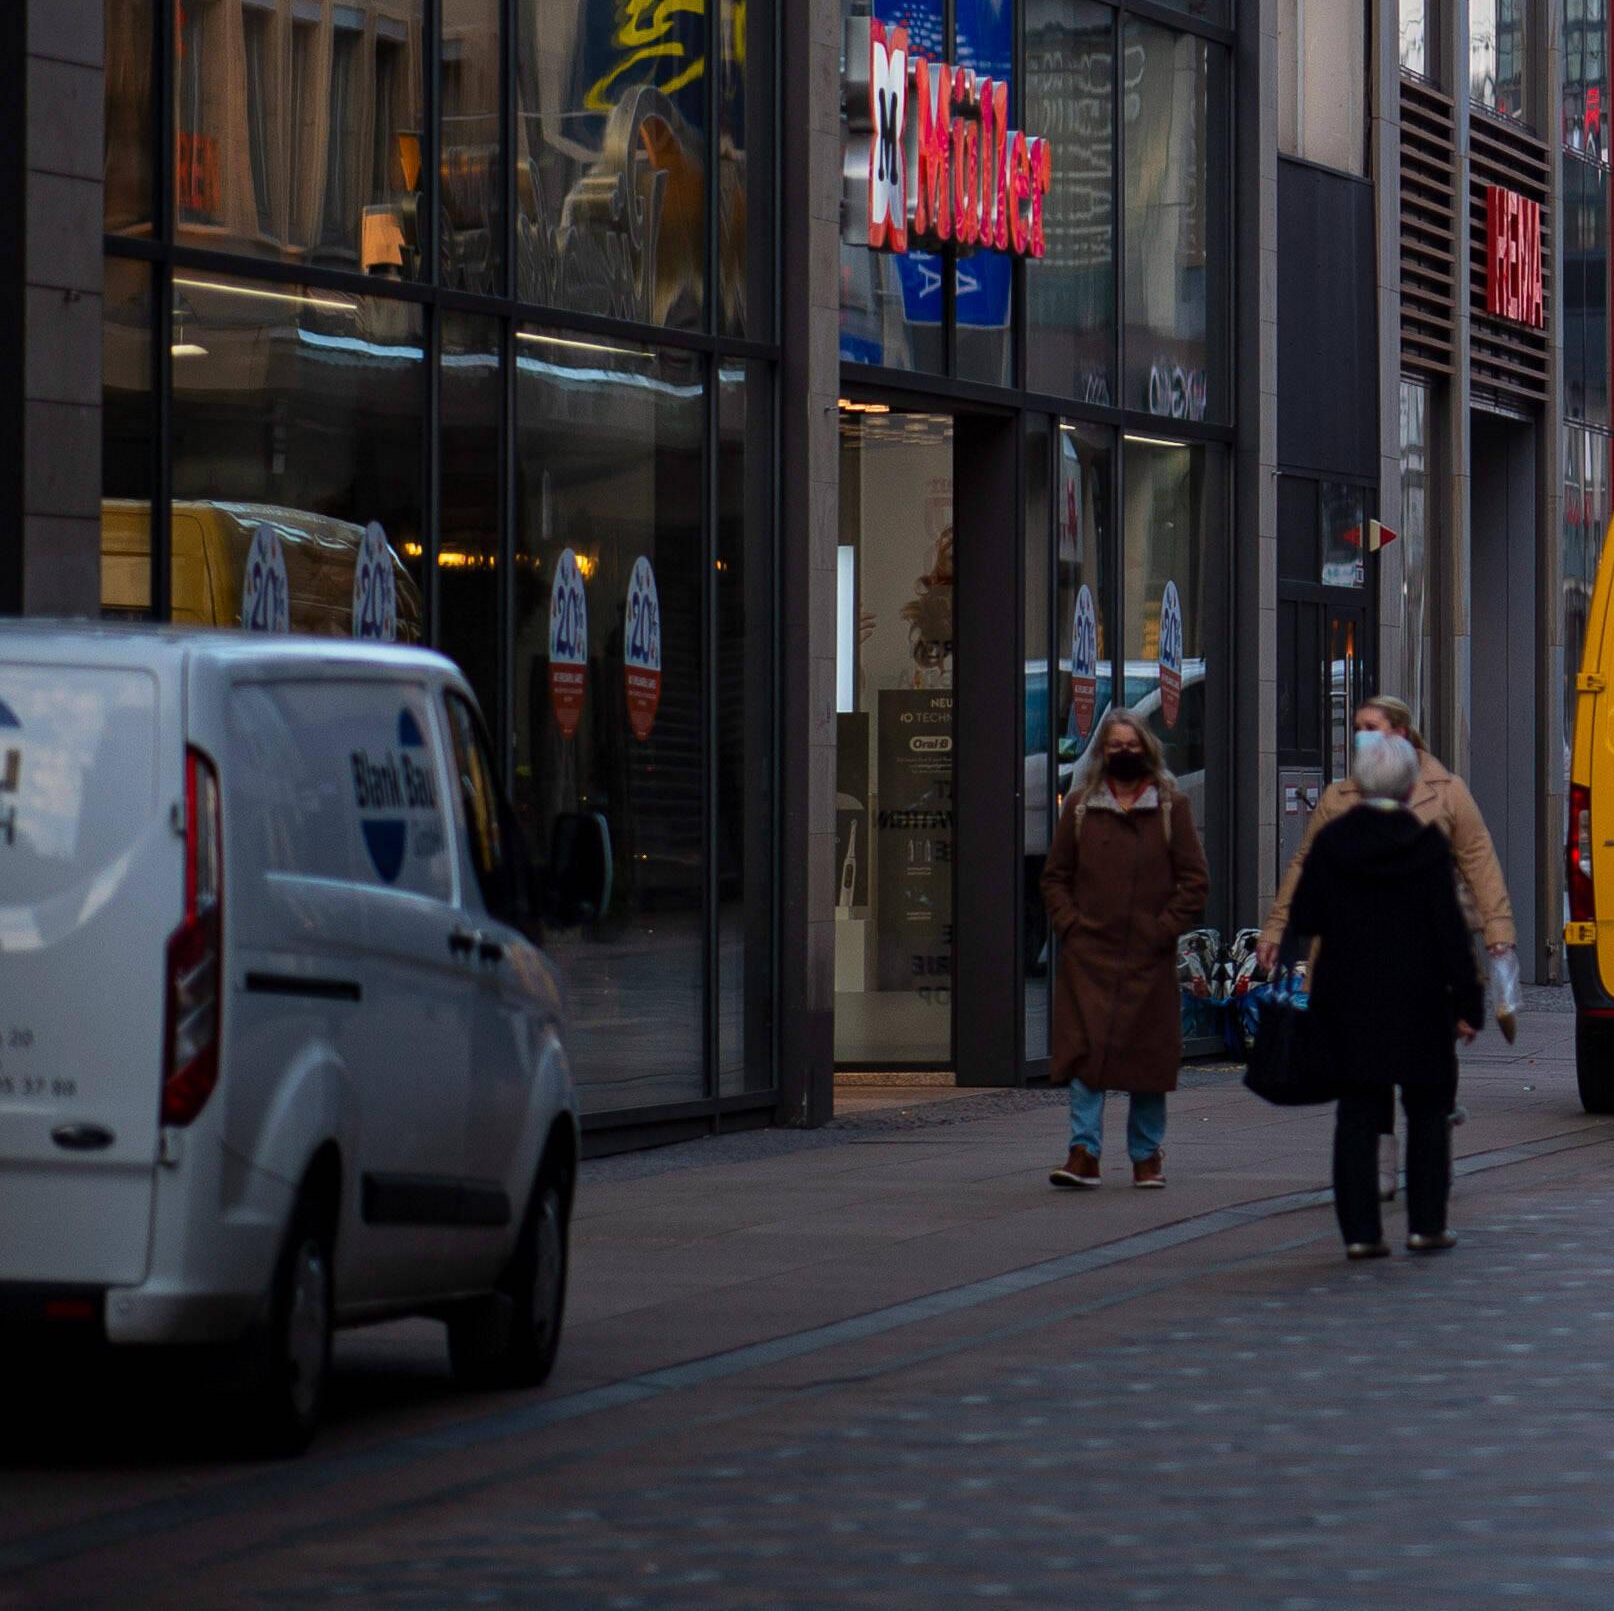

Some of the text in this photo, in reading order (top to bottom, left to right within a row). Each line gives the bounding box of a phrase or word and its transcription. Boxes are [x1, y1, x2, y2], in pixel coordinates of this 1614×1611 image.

[915, 56, 1051, 259] Müller
[1495, 186, 1543, 328] HEMA
[912, 737, 950, 751] Oral-B
